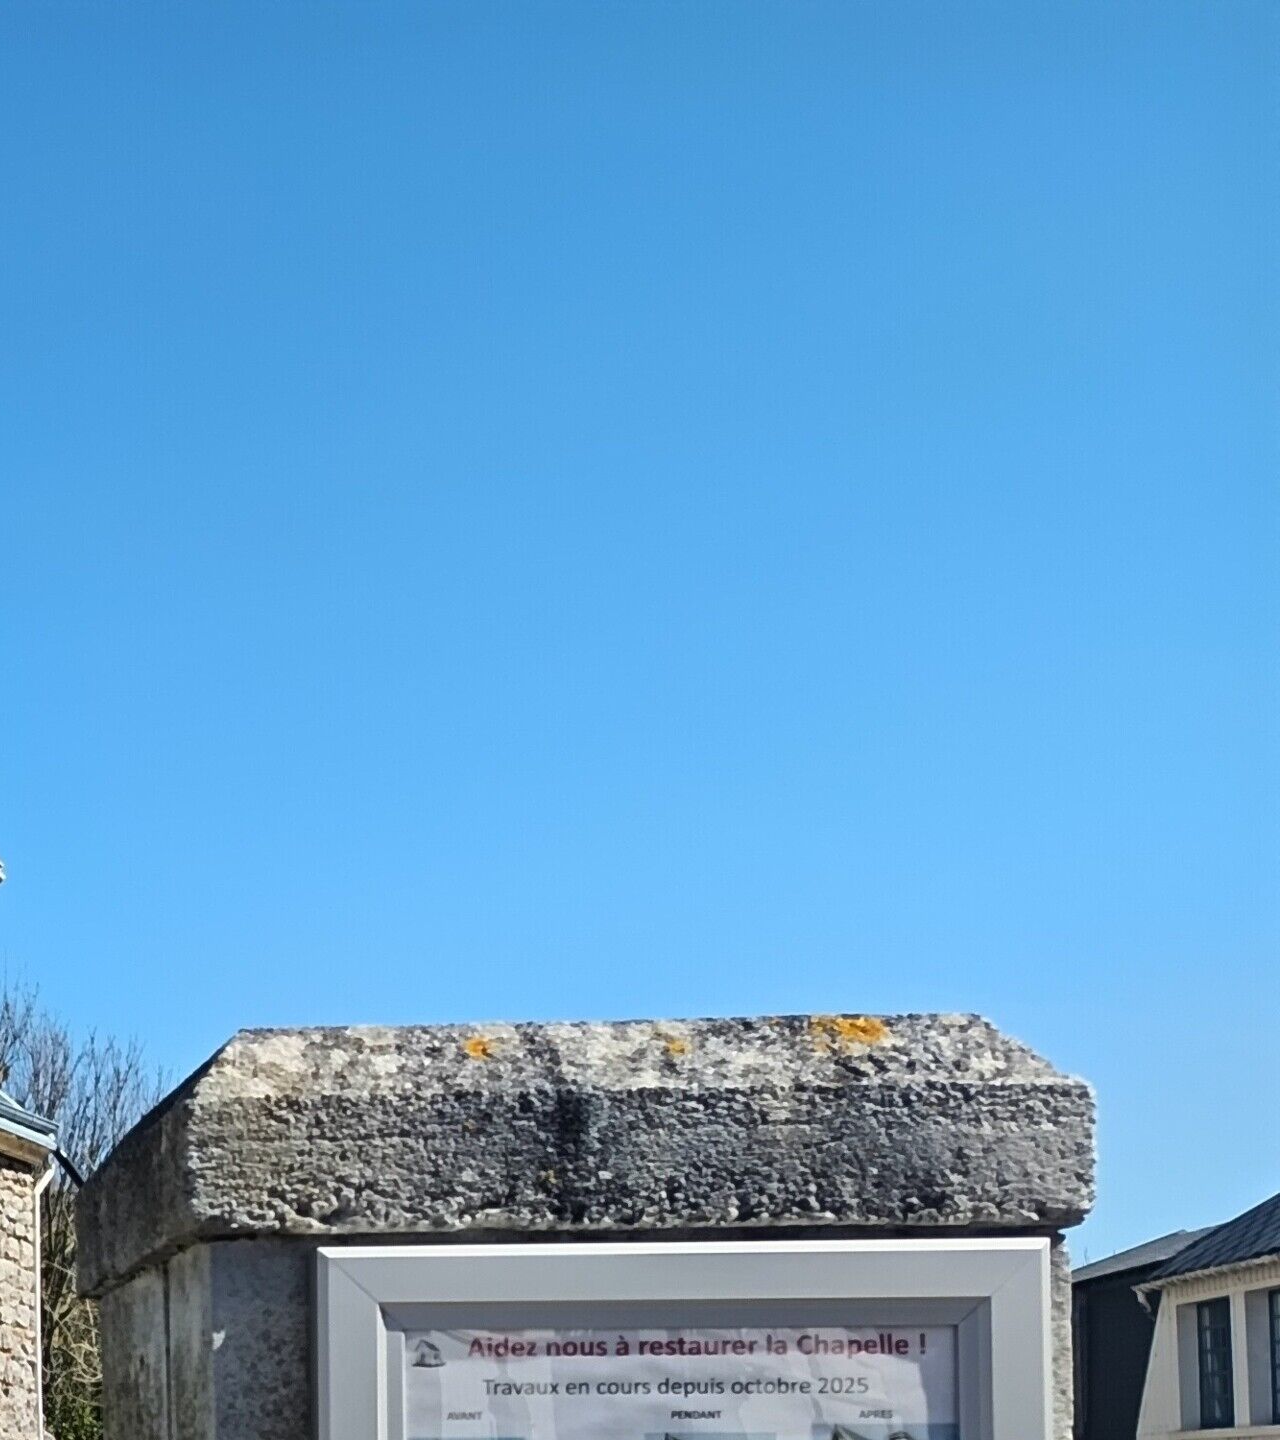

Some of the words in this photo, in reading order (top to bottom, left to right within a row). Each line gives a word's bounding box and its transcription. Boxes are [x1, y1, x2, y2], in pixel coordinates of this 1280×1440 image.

[468, 1335, 538, 1357] Aidez
[545, 1340, 608, 1357] nous
[615, 1335, 630, 1356] à
[639, 1337, 758, 1356] restaurer
[766, 1335, 788, 1355] la
[795, 1334, 910, 1360] Chapelle
[483, 1379, 559, 1396] Travaux
[565, 1382, 589, 1396] en
[596, 1382, 651, 1396] cours
[657, 1377, 725, 1399] depuis
[731, 1377, 811, 1394] octobre
[817, 1377, 870, 1394] 2025
[670, 1410, 722, 1420] PENDANT
